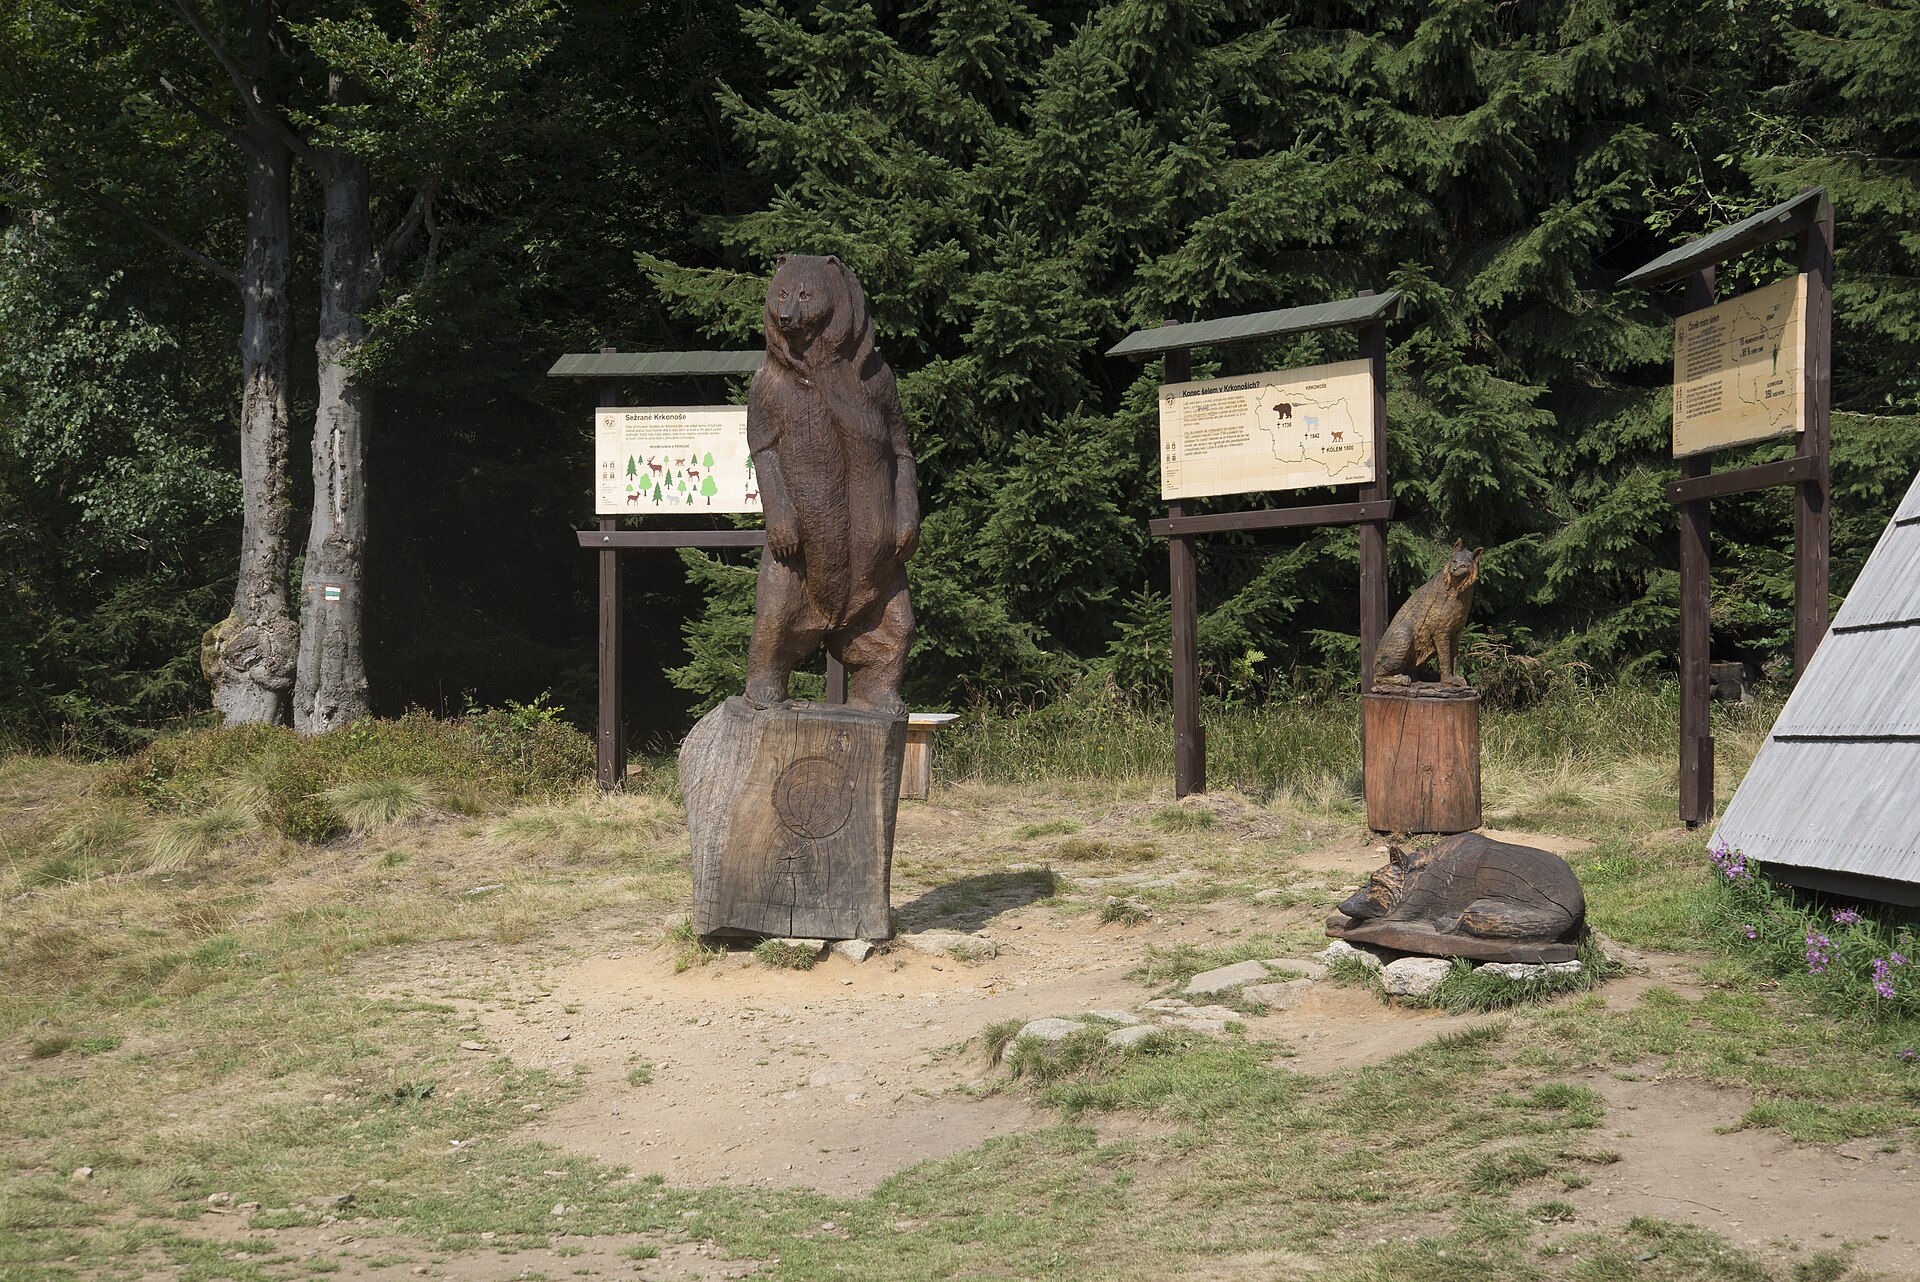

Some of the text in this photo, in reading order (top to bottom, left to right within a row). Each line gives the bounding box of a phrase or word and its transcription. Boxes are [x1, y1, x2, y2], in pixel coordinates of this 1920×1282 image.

[1182, 389, 1201, 397] Konec
[1201, 387, 1218, 395] šelem
[1223, 381, 1260, 392] Krkonoších?
[653, 413, 687, 421] Krkonoše
